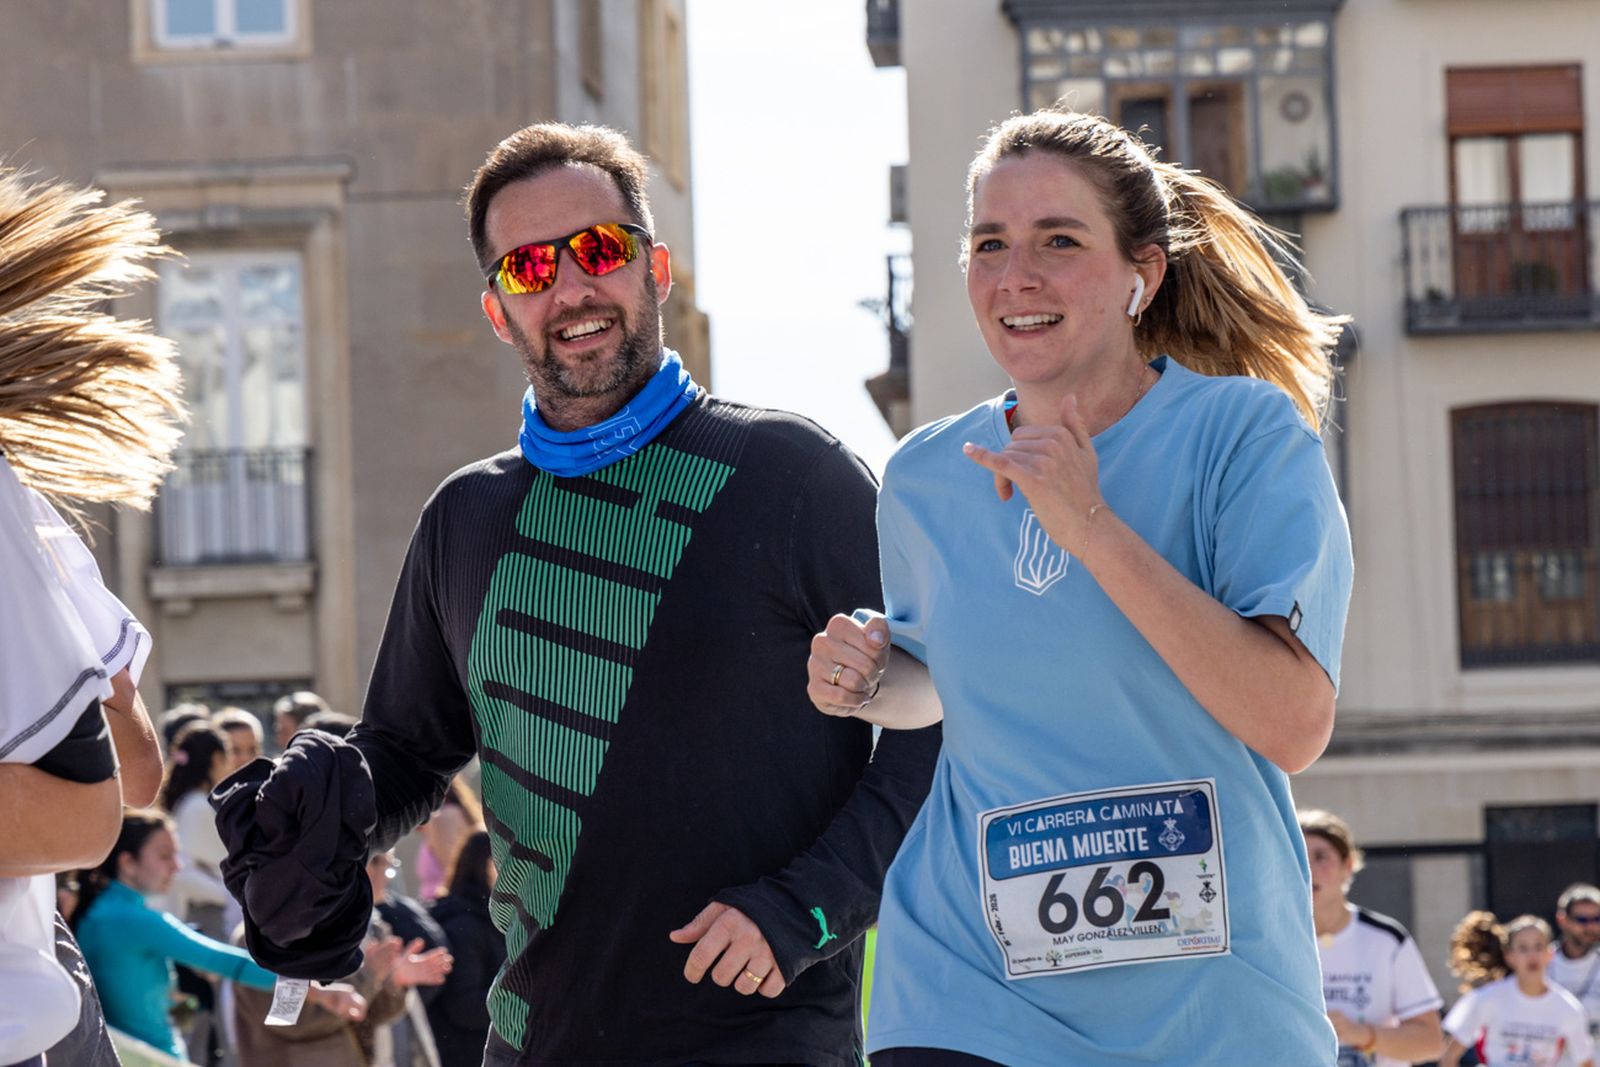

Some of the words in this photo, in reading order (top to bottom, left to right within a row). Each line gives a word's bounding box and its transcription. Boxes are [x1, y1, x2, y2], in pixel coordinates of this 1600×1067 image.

[1007, 820, 1022, 836] VI
[1025, 808, 1096, 833] CARRERA
[1100, 799, 1185, 820] CAMINATA
[1009, 838, 1069, 870] BUENA
[1073, 827, 1149, 859] MUERTE
[1037, 861, 1170, 935] 662
[1053, 933, 1074, 946] MAY
